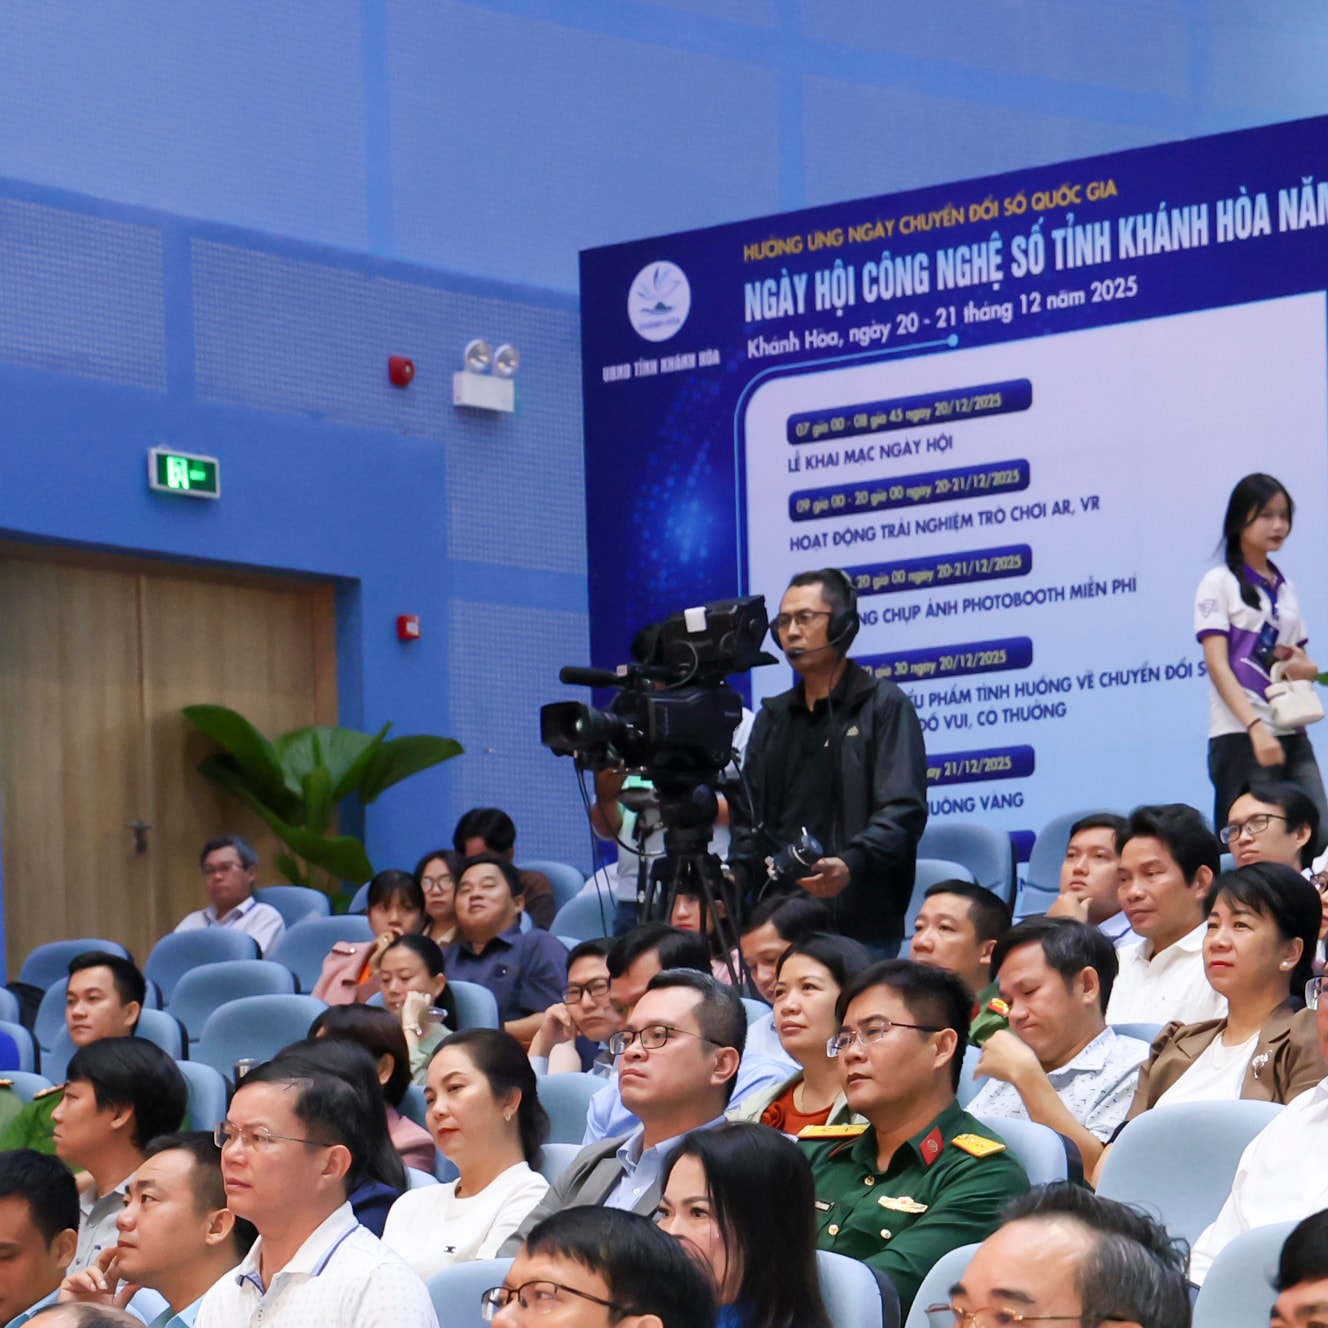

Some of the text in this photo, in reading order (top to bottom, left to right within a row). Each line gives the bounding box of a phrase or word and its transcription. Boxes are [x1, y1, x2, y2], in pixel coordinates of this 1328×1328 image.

[1086, 178, 1118, 201] GIA
[744, 267, 809, 323] NGÀY
[815, 257, 855, 317] HỘI
[862, 249, 929, 304] CÔNG
[936, 230, 1004, 291] NGHỆ
[1011, 216, 1045, 278] SỐ
[1051, 211, 1112, 271] TỈNH
[1118, 200, 1209, 260] KHÁNH
[1216, 185, 1272, 244] HÒA
[747, 328, 800, 360] Khánh
[849, 317, 891, 347] ngày
[896, 311, 919, 335] 20
[936, 305, 958, 329] 21
[963, 300, 1013, 324] tháng
[1020, 293, 1042, 315] 12
[1047, 287, 1085, 311] năm
[1090, 276, 1138, 303] 2025
[805, 451, 839, 471] KHAI
[926, 432, 953, 454] HỘI
[915, 511, 973, 534] NGHIỆM
[1080, 494, 1100, 512] VR
[883, 604, 921, 626] CHỤP
[963, 586, 1065, 613] PHOTOBOOTH
[1197, 661, 1208, 678] S
